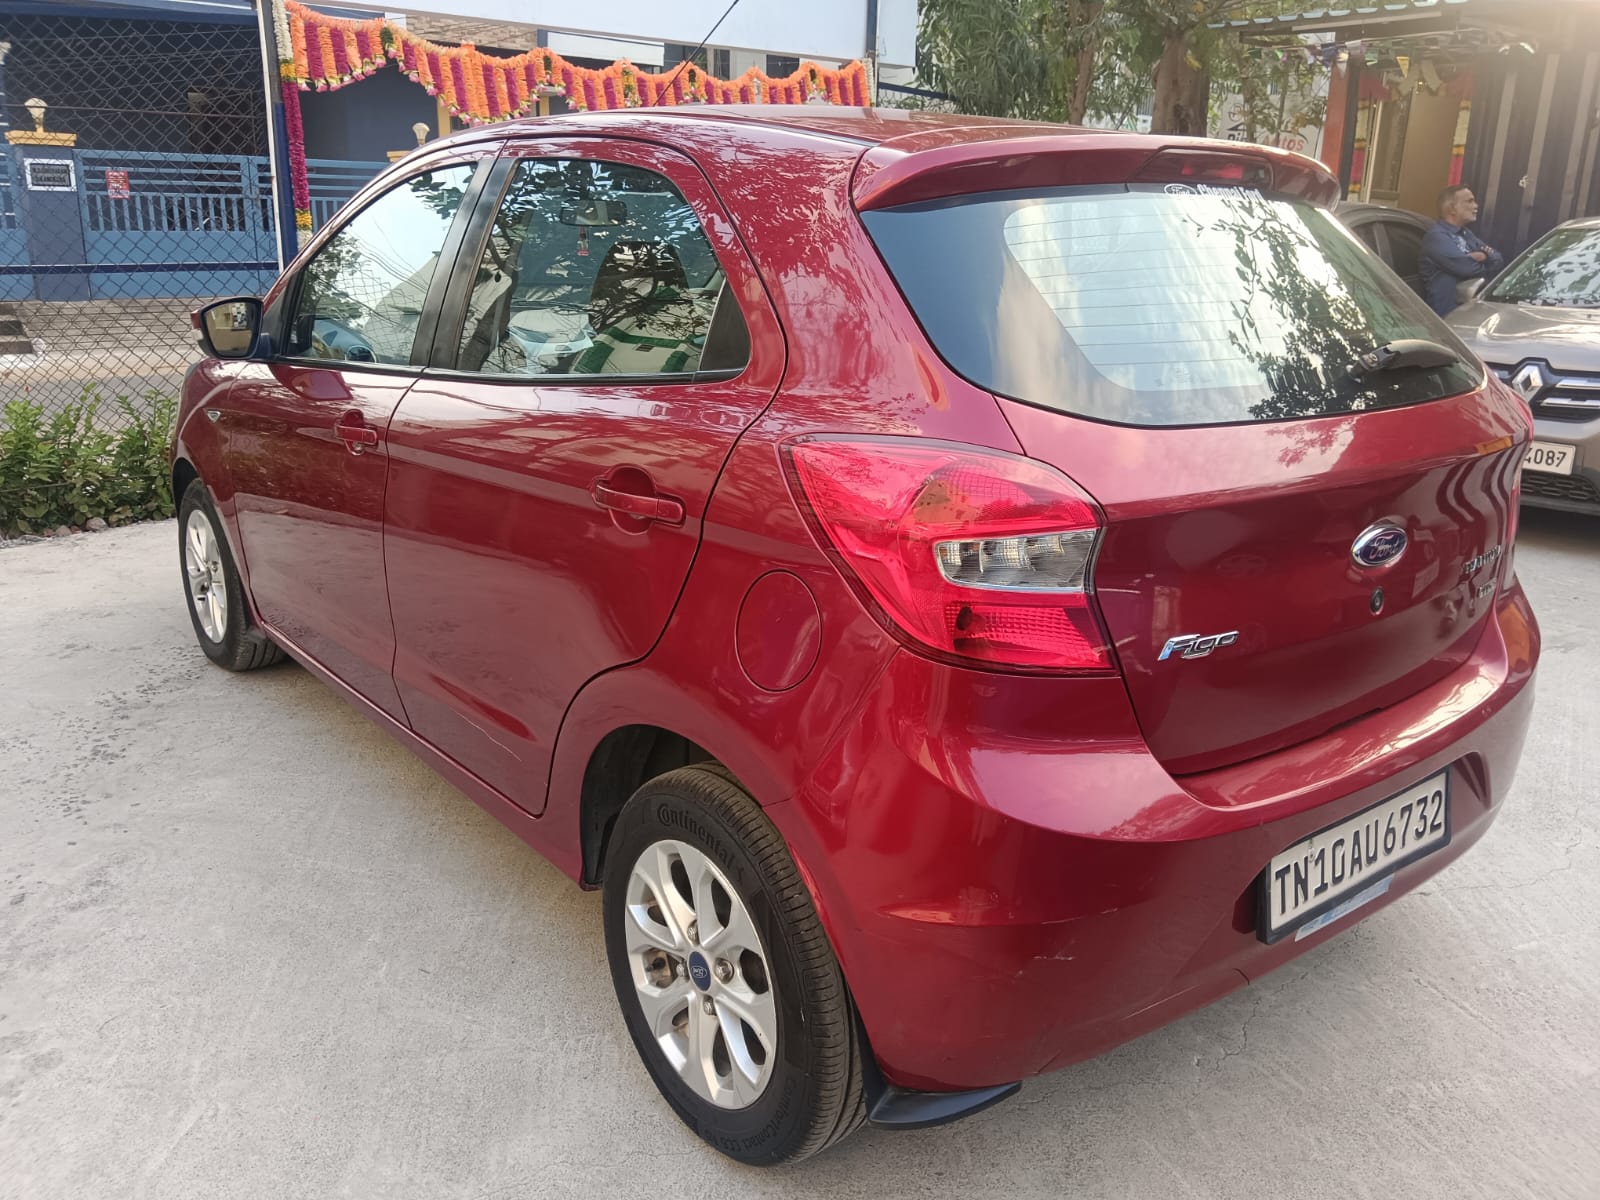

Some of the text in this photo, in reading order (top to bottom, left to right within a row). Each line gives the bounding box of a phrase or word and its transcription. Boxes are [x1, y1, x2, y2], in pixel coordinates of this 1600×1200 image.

[1367, 532, 1402, 561] Ford
[1157, 630, 1239, 661] Figo
[656, 802, 735, 870] Continental
